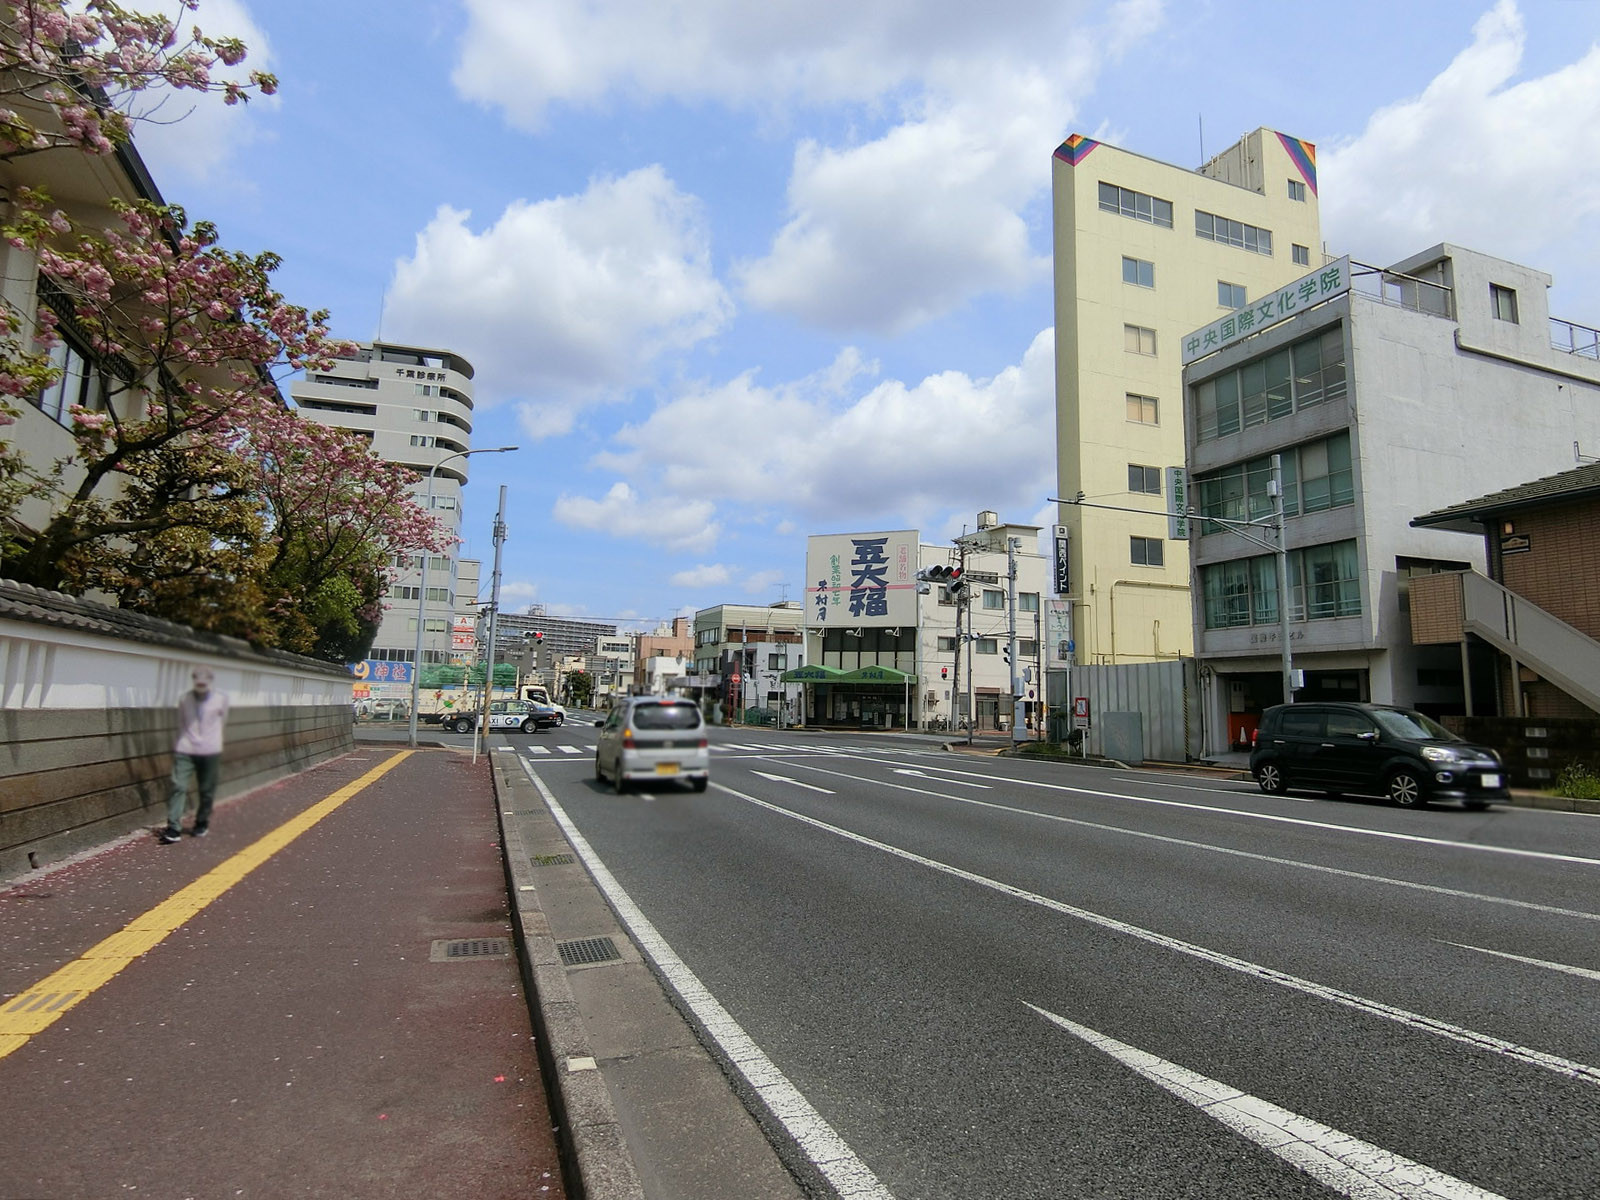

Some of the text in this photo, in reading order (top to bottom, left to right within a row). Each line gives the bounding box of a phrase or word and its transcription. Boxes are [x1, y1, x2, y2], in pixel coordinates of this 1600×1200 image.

[1187, 268, 1340, 355] 中央国際文化学院
[396, 368, 447, 382] 千葉診療所
